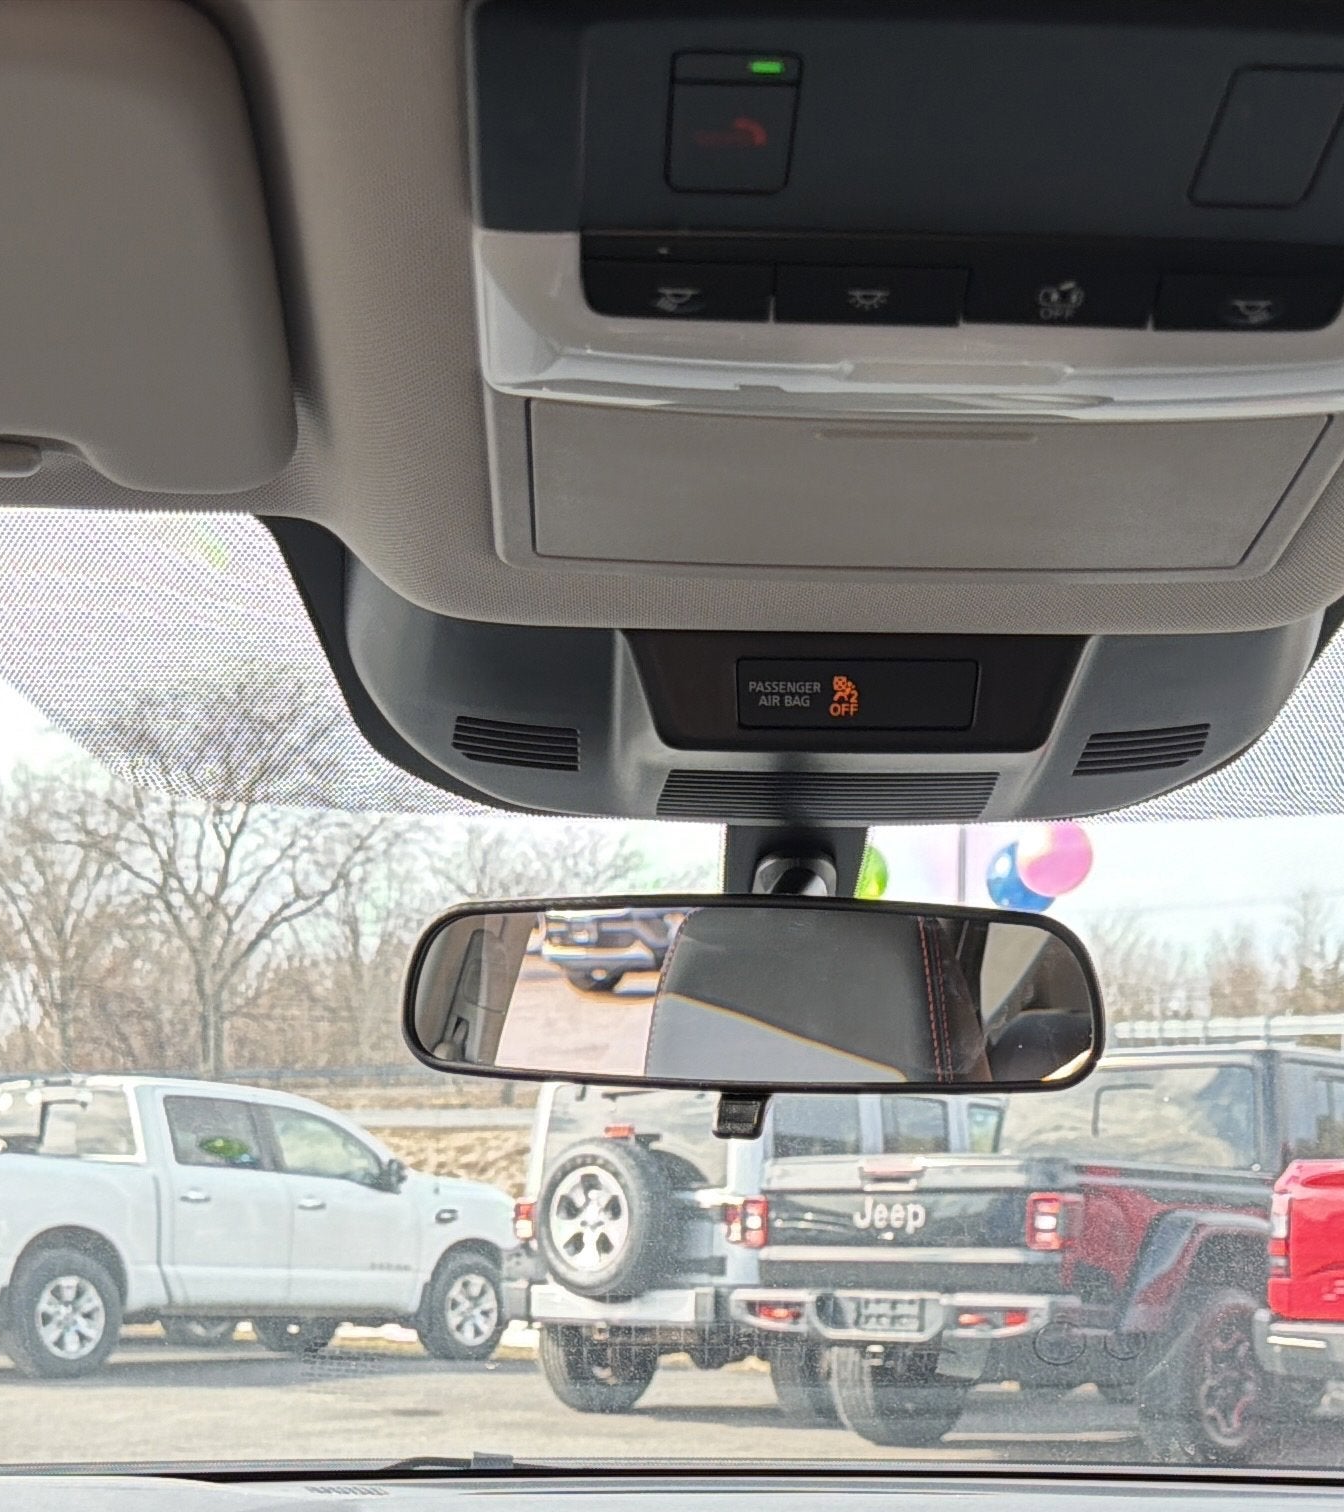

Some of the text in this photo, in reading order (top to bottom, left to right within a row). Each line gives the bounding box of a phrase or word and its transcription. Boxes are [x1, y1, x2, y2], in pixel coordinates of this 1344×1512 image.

[748, 681, 822, 694] PASSENGER
[758, 695, 859, 717] AIR BAG OFF
[853, 1196, 926, 1234] Jeep
